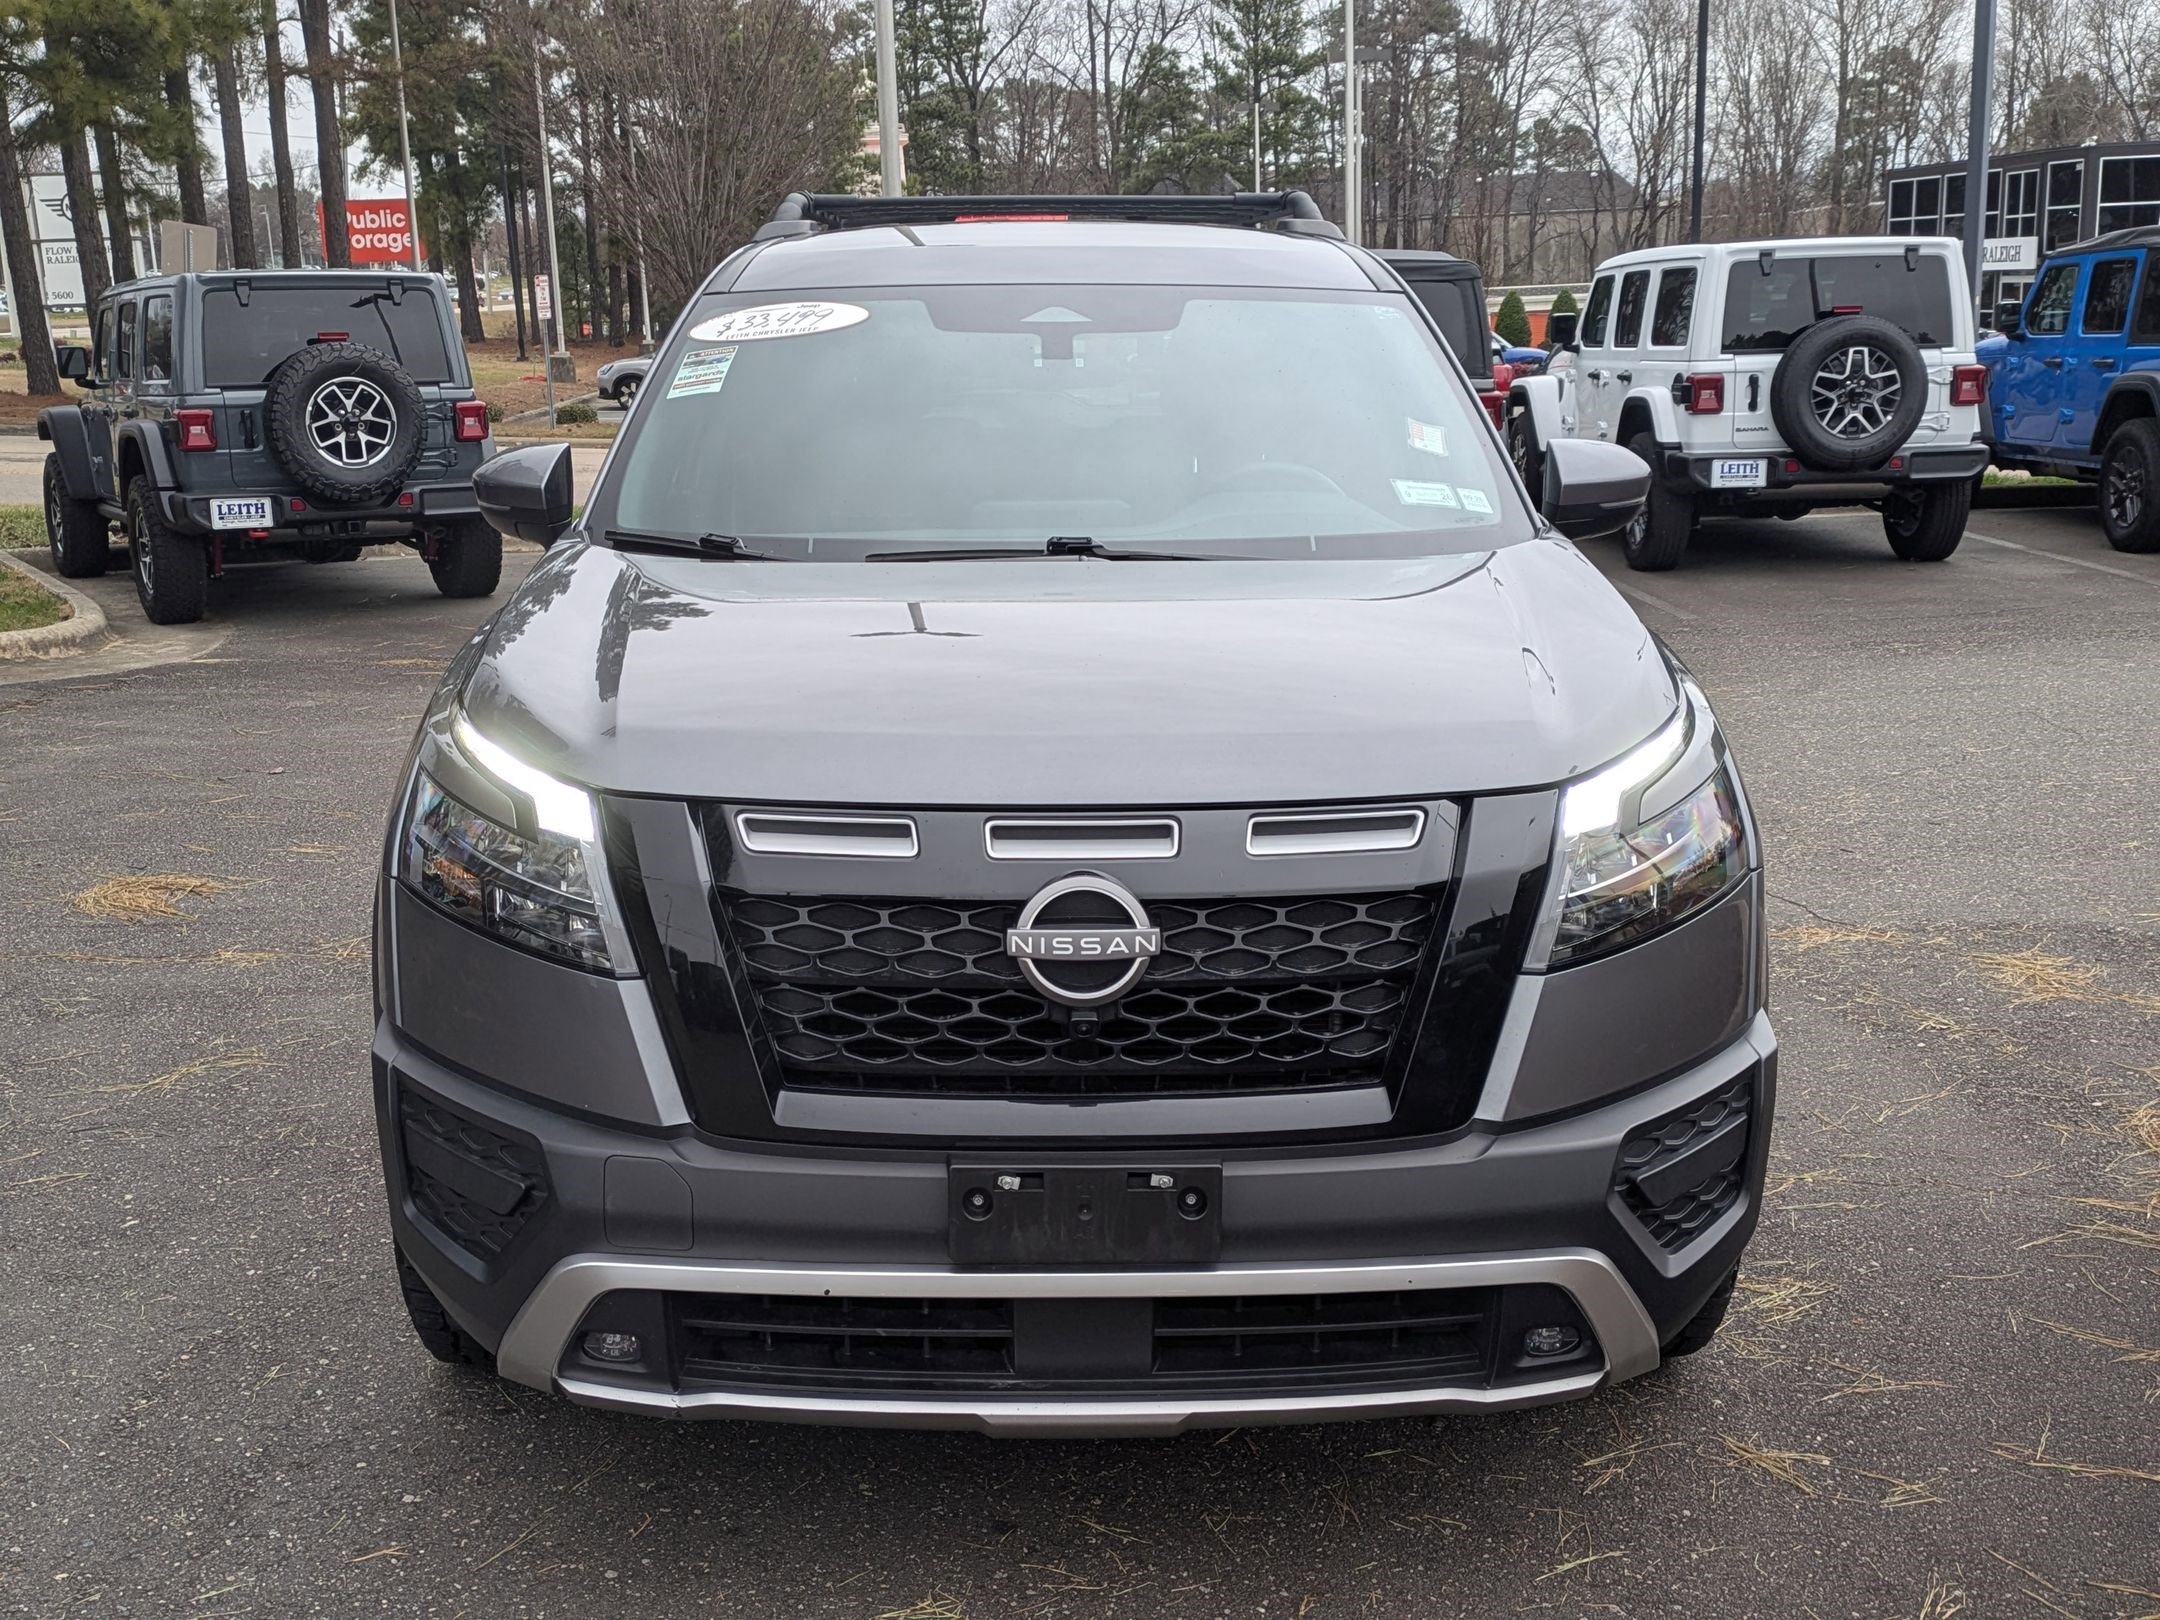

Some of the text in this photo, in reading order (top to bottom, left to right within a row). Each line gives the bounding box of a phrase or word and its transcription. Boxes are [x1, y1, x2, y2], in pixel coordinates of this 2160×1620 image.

[351, 233, 412, 252] orage
[45, 246, 73, 255] FLOW
[1983, 245, 2022, 263] RALEIGH
[52, 291, 74, 300] 5600
[726, 331, 750, 340] LEITH
[752, 327, 796, 337] CHRYSLER
[1720, 463, 1759, 474] LEITH
[216, 503, 266, 515] LEITH
[1011, 934, 1156, 955] NISSAN
